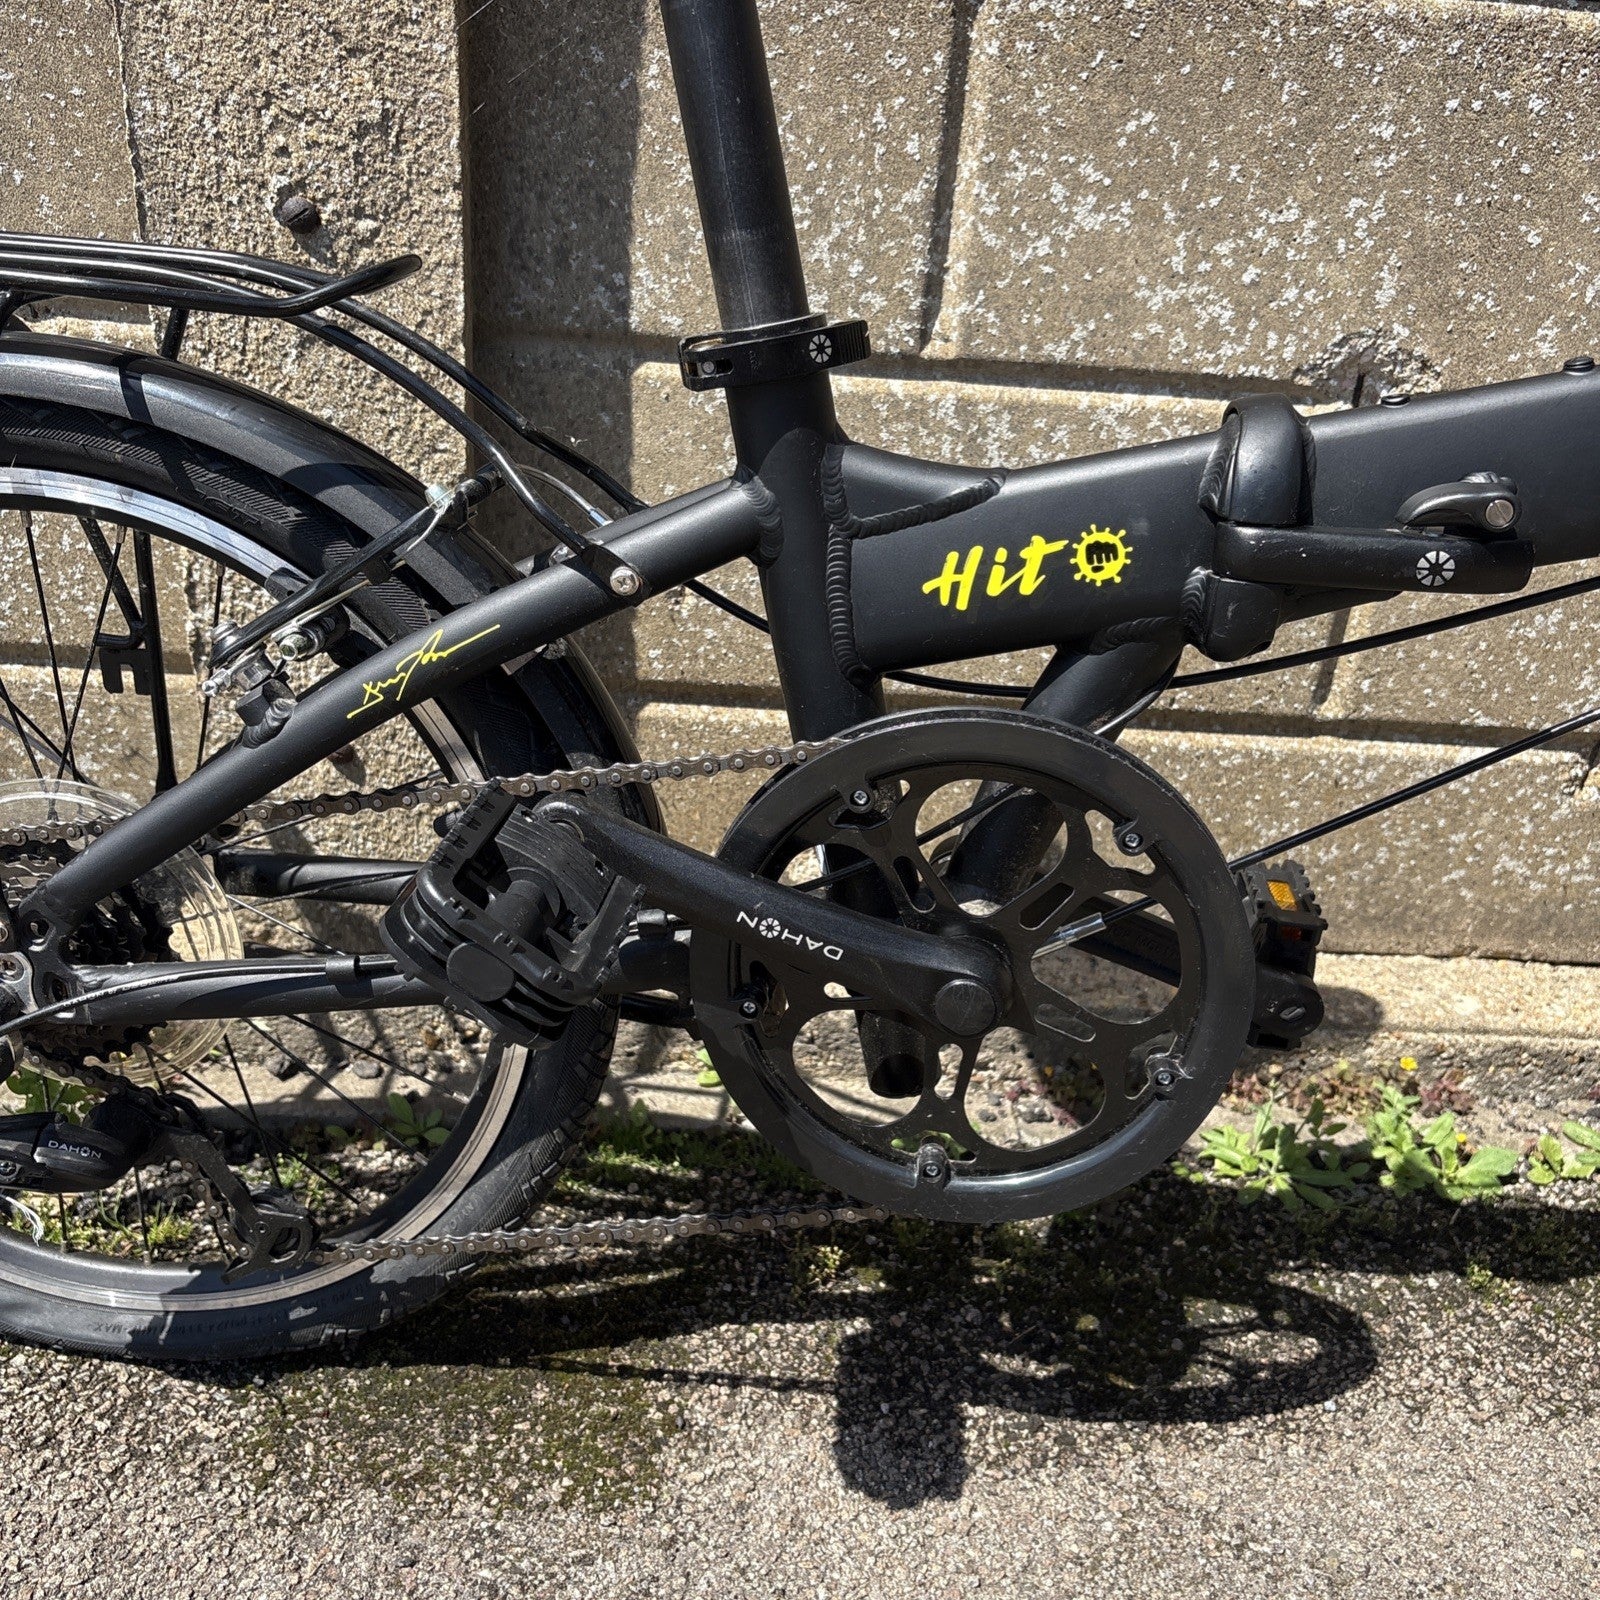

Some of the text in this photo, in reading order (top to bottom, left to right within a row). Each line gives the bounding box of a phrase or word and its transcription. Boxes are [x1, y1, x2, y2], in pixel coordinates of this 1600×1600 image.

[922, 535, 1069, 611] Hit
[736, 911, 844, 961] DAHON
[48, 1140, 102, 1159] DAHON
